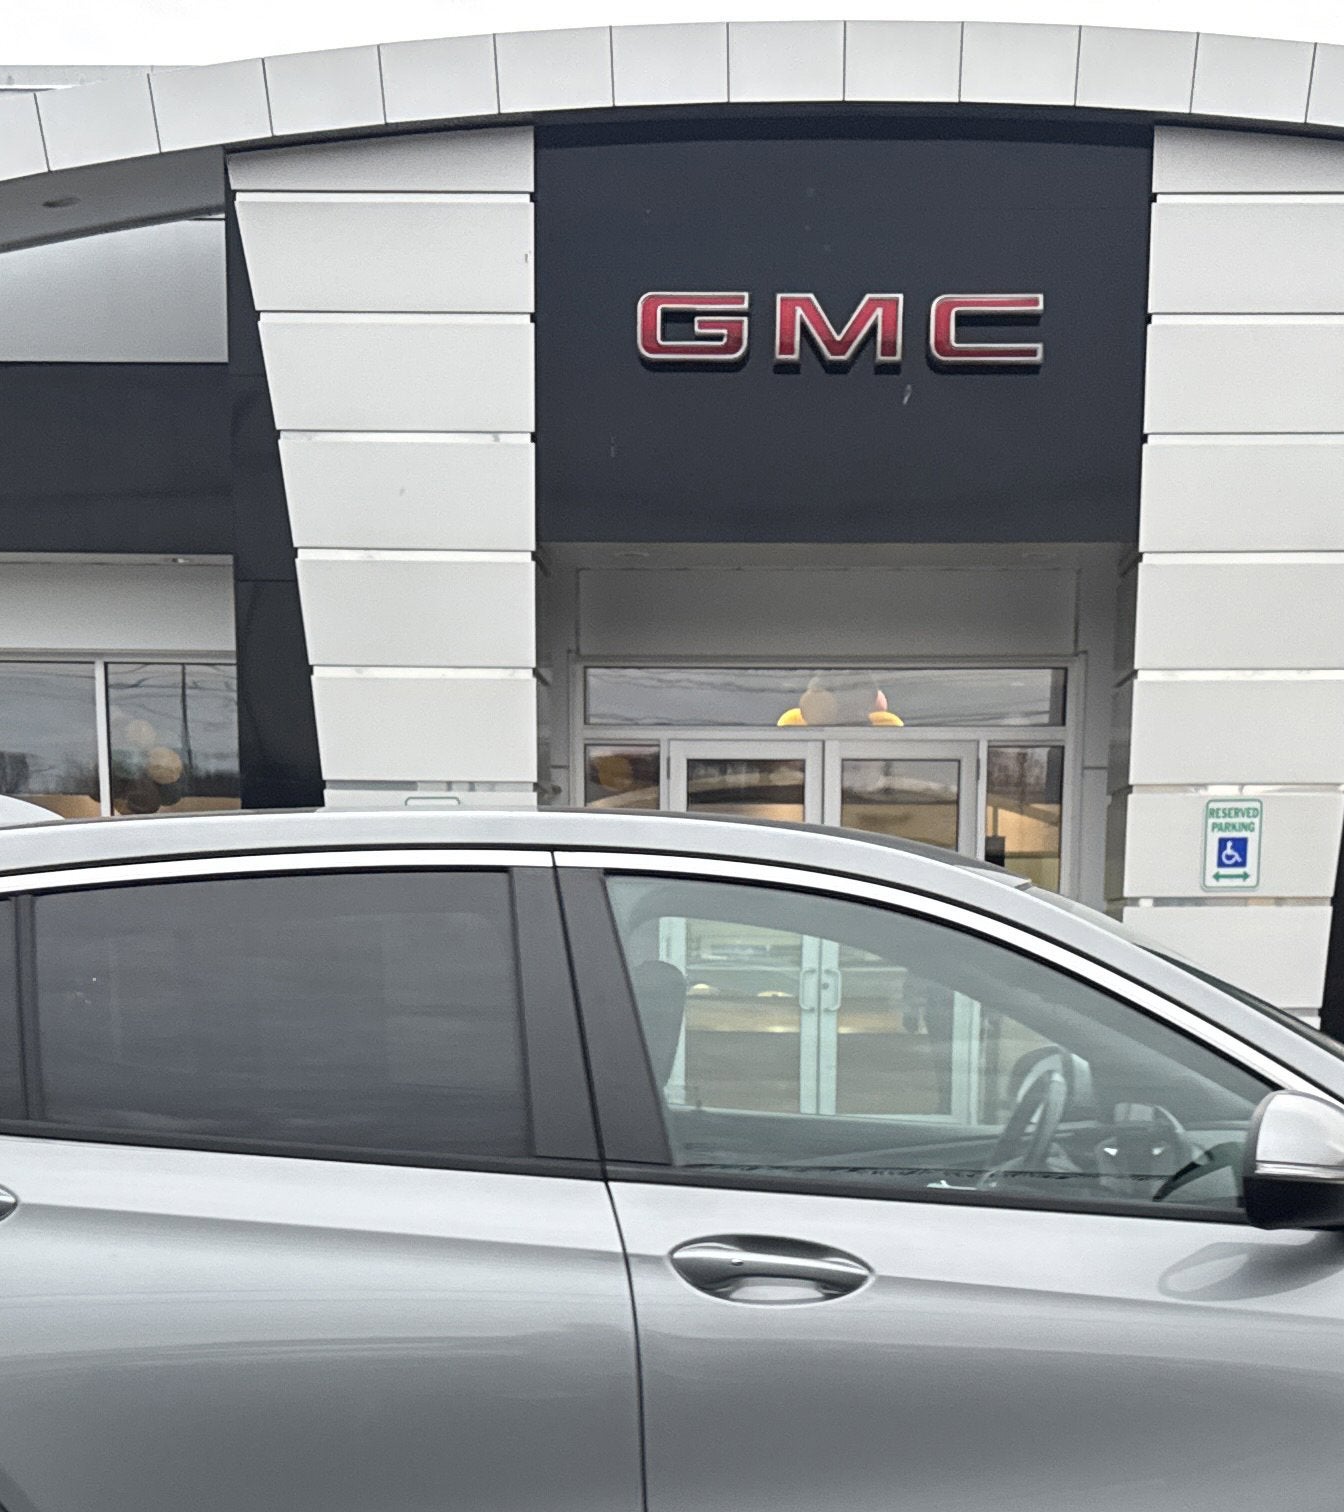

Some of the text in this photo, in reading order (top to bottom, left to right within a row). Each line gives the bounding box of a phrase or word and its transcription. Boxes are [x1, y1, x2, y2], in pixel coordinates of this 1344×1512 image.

[637, 291, 1044, 363] GMC
[1208, 807, 1259, 819] RESERVED
[1211, 821, 1255, 833] PARKING
